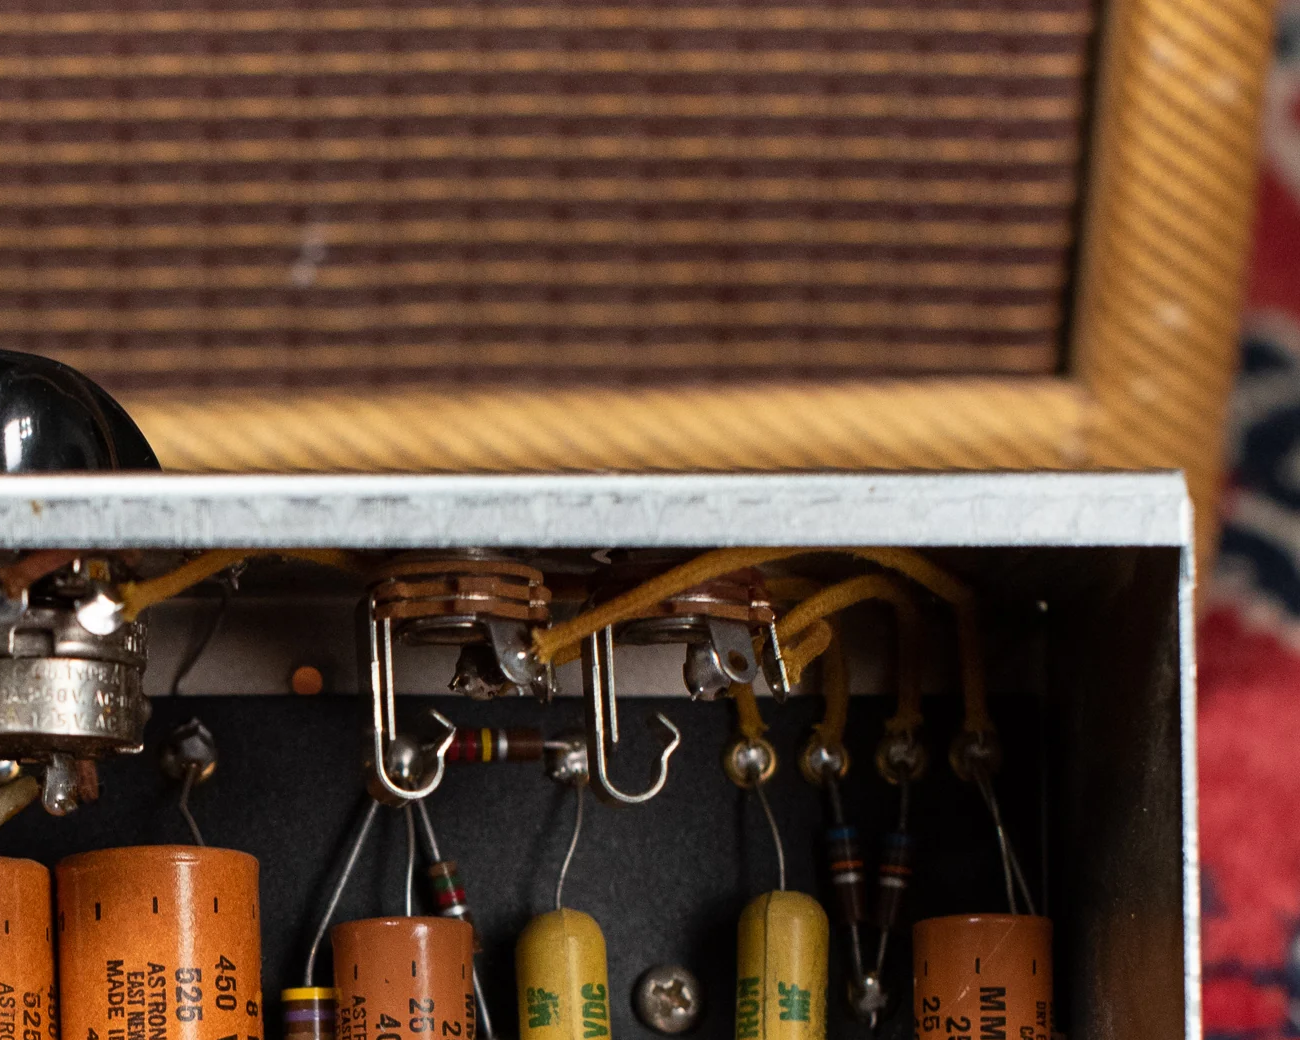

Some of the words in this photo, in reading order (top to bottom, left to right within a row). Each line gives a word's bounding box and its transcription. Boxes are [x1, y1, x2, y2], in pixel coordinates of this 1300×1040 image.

[106, 959, 125, 1020] MADE
[127, 971, 146, 1007] EAST
[175, 967, 203, 1023] 525
[215, 954, 237, 1012] 450
[778, 981, 811, 1022] MF
[246, 1000, 259, 1017] 8
[409, 998, 435, 1033] 25
[581, 983, 608, 1039] VDC
[922, 996, 941, 1032] 25
[1036, 1001, 1046, 1029] DRY
